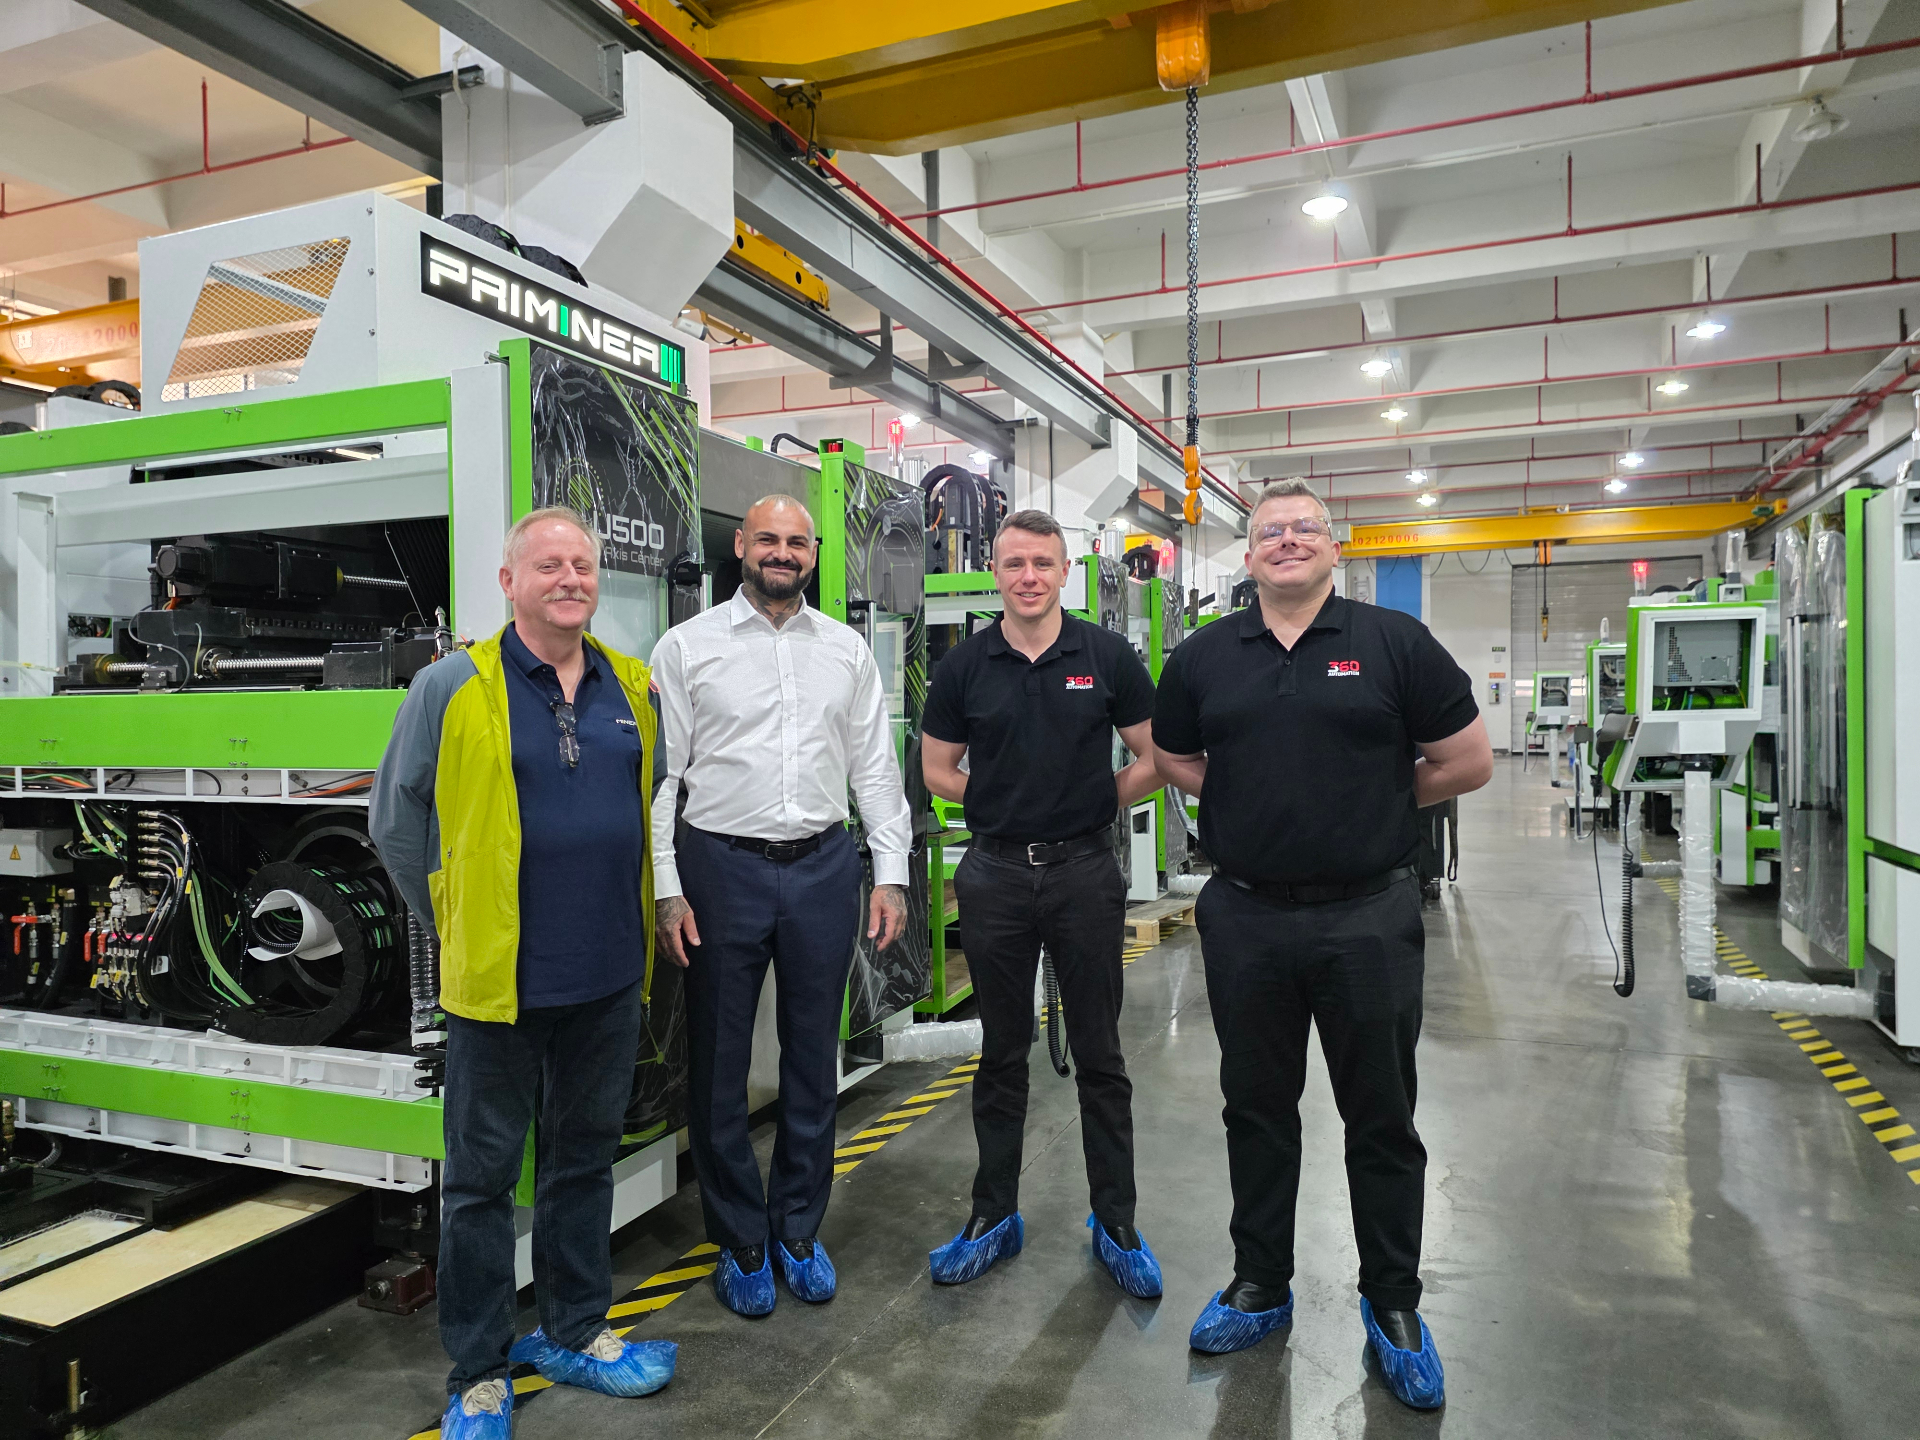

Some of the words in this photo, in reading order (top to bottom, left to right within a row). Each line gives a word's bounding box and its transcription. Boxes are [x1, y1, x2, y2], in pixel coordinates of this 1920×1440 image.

[429, 248, 660, 374] PRIMINER
[593, 510, 665, 550] U500
[630, 551, 665, 567] Center
[1327, 660, 1360, 672] 360
[1065, 676, 1093, 686] 360
